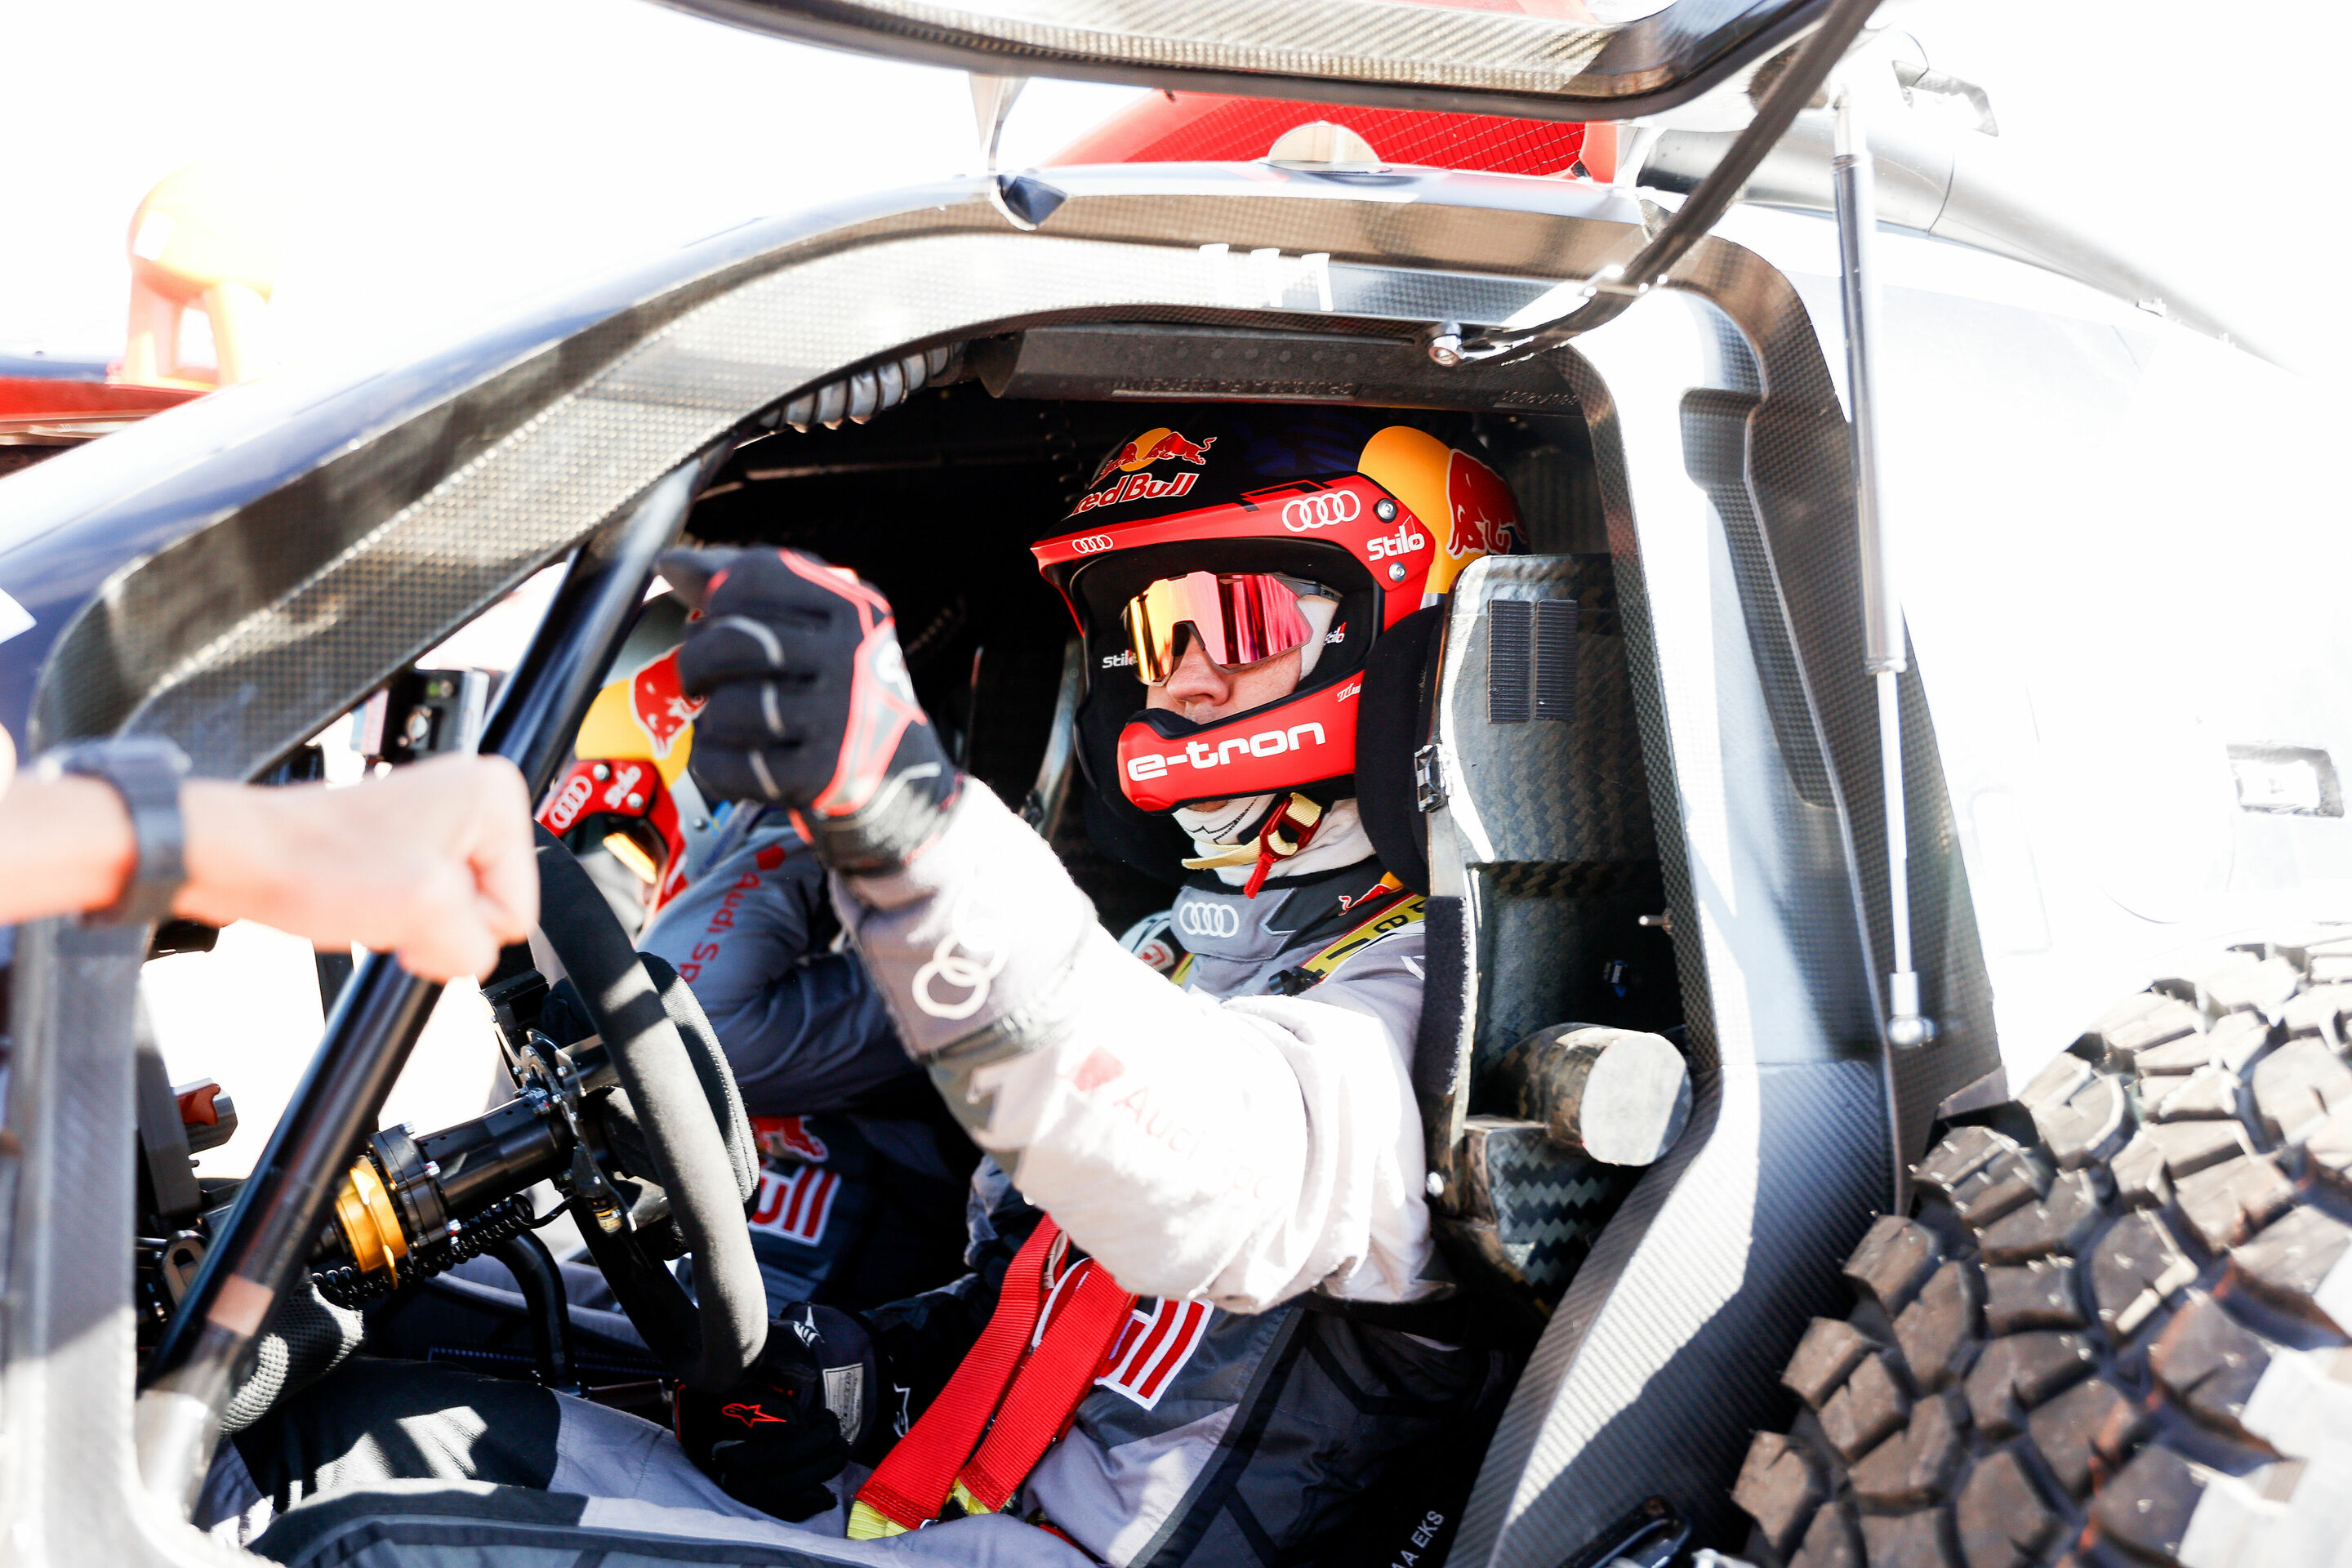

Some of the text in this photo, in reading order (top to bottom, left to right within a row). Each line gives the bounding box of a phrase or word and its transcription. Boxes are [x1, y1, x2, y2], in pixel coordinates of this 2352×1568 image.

[1118, 472, 1200, 504] Bull
[1127, 722, 1326, 782] e-tron
[1410, 1510, 1444, 1548] EKS
